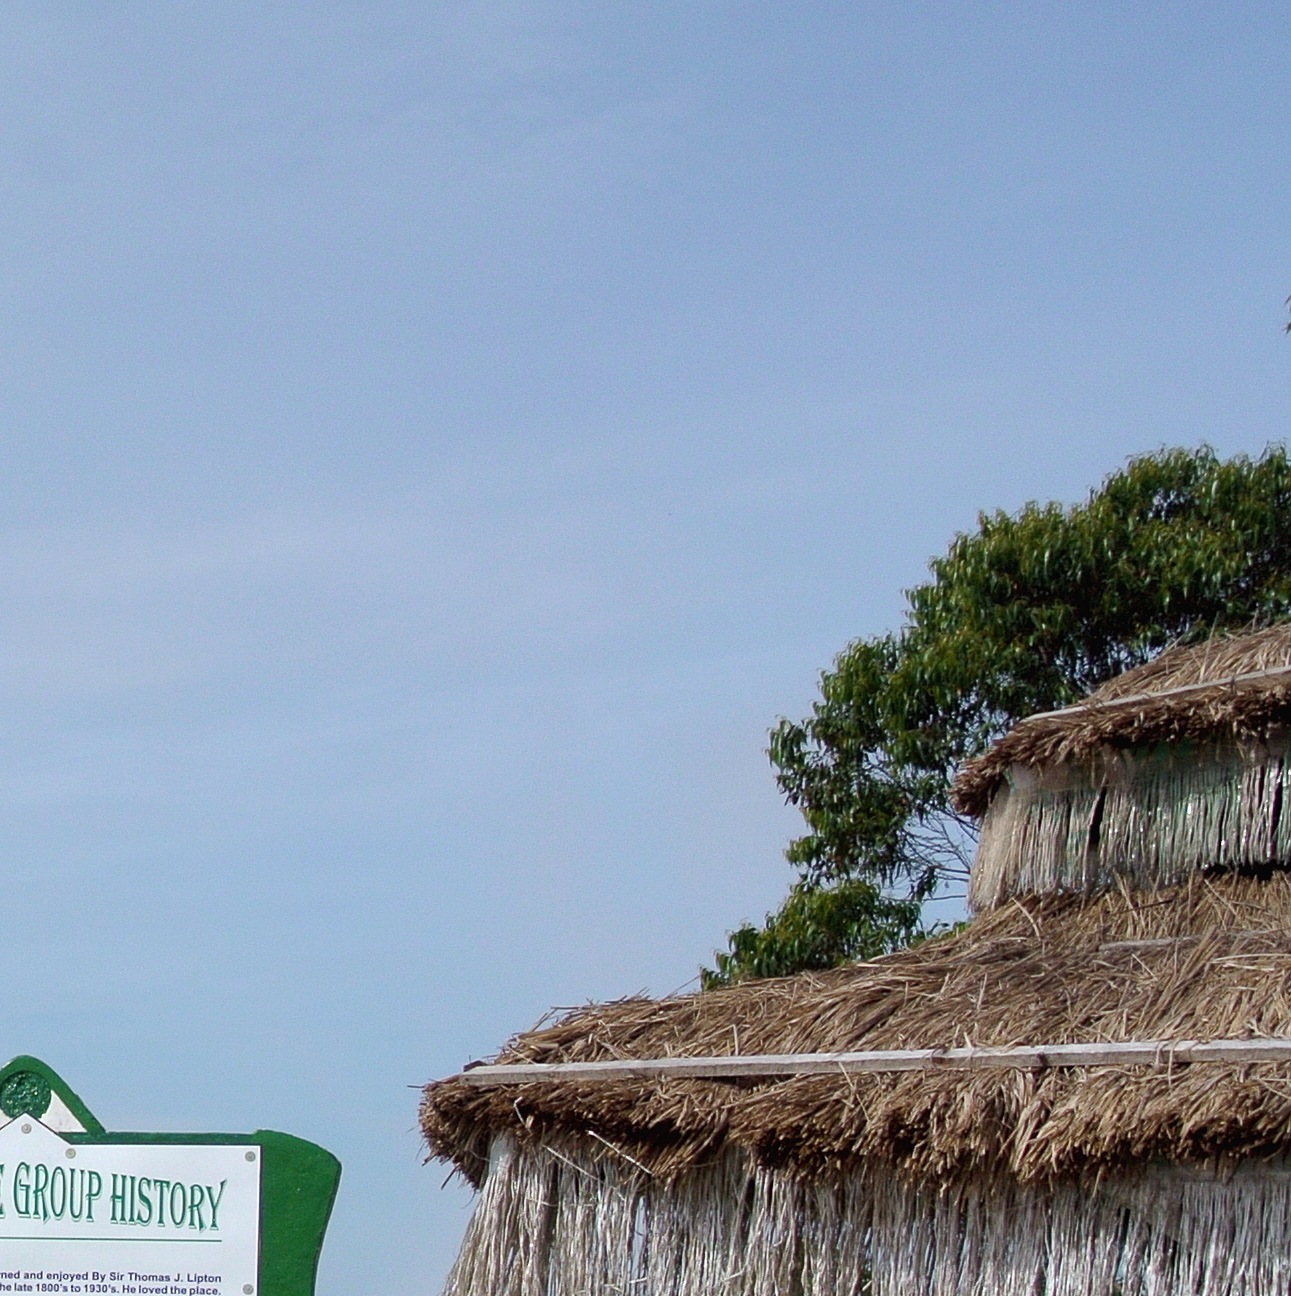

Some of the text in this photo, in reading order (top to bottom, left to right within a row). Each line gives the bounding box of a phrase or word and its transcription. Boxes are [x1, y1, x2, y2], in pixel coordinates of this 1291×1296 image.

[13, 1161, 102, 1226] GROUP
[109, 1172, 227, 1232] HISTORY
[23, 1270, 43, 1279] and
[46, 1270, 88, 1282] enjoyed
[91, 1271, 106, 1283] By
[109, 1271, 124, 1281] Sir
[127, 1272, 170, 1282] Thomas
[173, 1272, 183, 1282] J.
[187, 1273, 221, 1285] Lipton
[14, 1282, 32, 1292] late
[35, 1283, 68, 1292] 1800's
[70, 1284, 81, 1292] to
[84, 1283, 119, 1293] 1930's.
[122, 1284, 136, 1294] He
[138, 1284, 168, 1294] loved
[169, 1285, 187, 1295] the
[189, 1285, 221, 1296] place.
